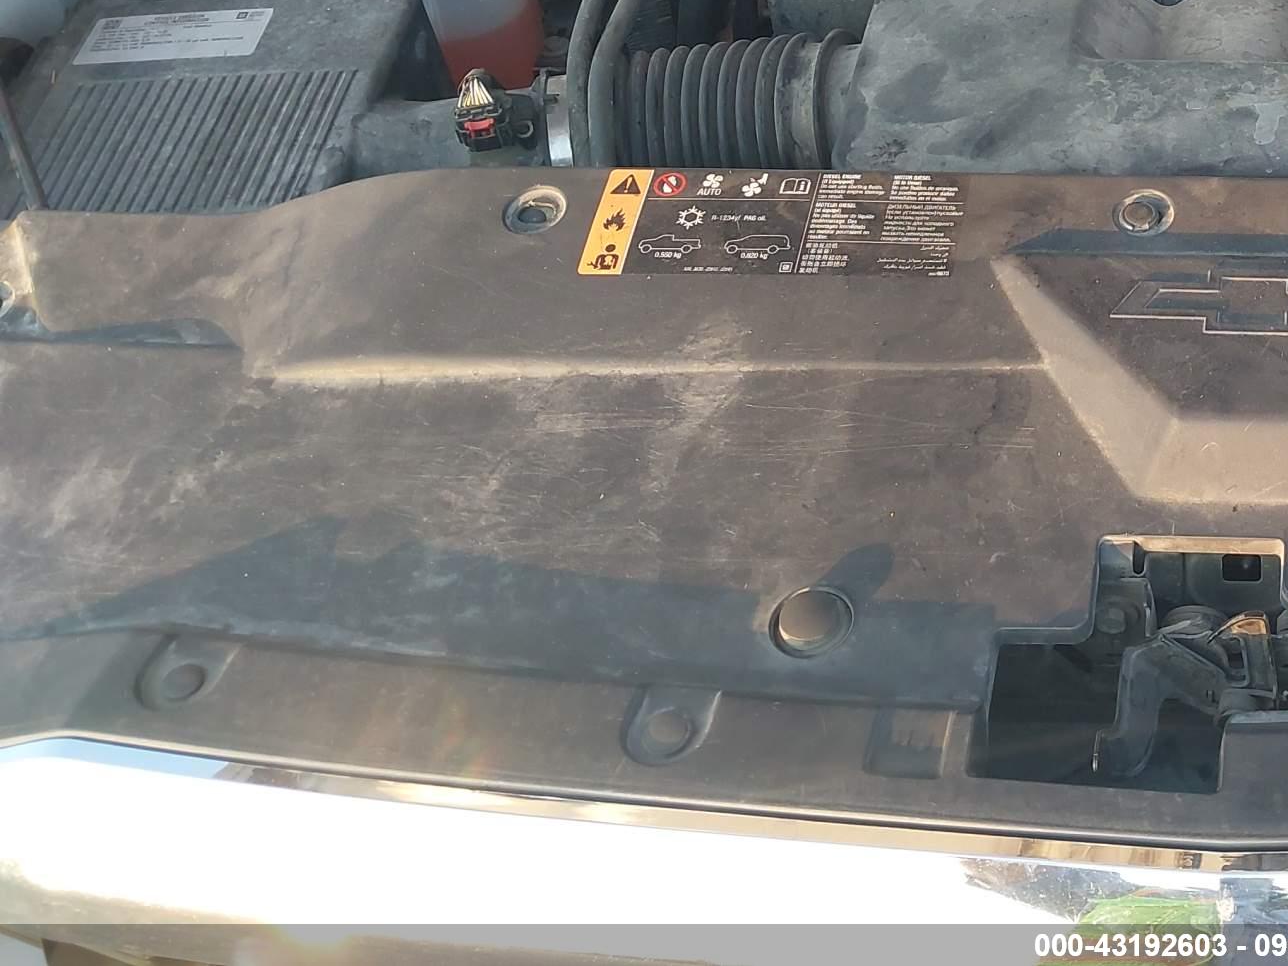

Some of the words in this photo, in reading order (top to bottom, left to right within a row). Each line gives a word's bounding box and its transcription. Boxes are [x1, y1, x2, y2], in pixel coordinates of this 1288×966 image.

[696, 188, 722, 196] AUTO
[673, 251, 682, 259] kg
[759, 252, 769, 260] kg
